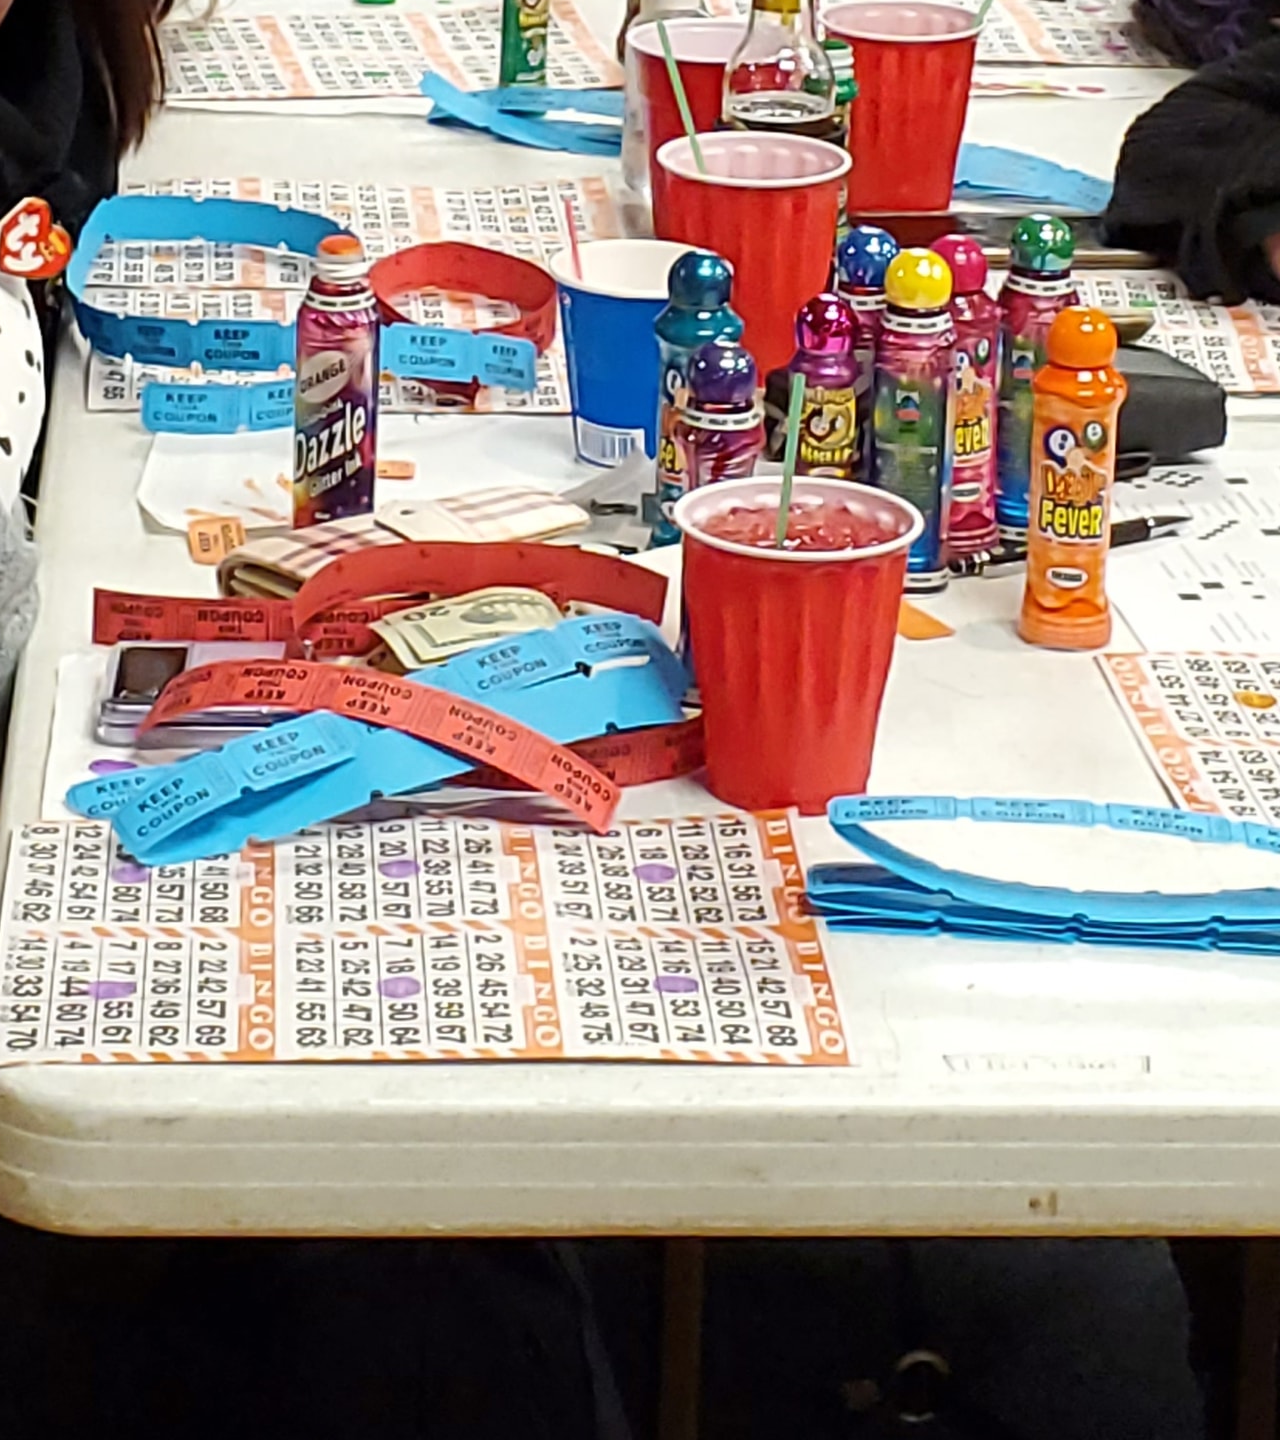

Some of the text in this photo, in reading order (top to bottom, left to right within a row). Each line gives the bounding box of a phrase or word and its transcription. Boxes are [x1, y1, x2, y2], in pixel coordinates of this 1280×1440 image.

[410, 335, 446, 347] KEEP
[299, 358, 346, 394] ORANGE
[153, 410, 217, 422] COUPON
[166, 393, 206, 403] KEEP
[295, 401, 366, 482] Dazzle
[242, 666, 308, 680] COUPON
[477, 645, 521, 668] KEEP
[477, 659, 547, 690] COUPON
[244, 690, 286, 700] KEEP
[343, 674, 412, 699] COUPON
[346, 699, 391, 716] KEEP
[449, 705, 517, 742] COUPON
[252, 731, 299, 754] KEEP
[453, 731, 496, 755] KEEP
[252, 745, 326, 777] COUPON
[551, 754, 610, 801] COUPON
[137, 777, 184, 813] KEEP
[137, 788, 210, 837] COUPON
[554, 782, 593, 812] KEEP
[28, 863, 55, 875] 37
[29, 844, 58, 859] 30
[420, 820, 455, 916] 11 22 39 55 70
[719, 818, 767, 921] 15 16 31 56 73
[25, 879, 53, 897] 46
[678, 824, 723, 923] 11 28 42 52 62
[22, 903, 51, 921] 62
[199, 960, 227, 973] 22
[6, 938, 47, 1050] 14 30 33 54 70
[102, 942, 137, 1043] 7 17 55 61
[149, 942, 182, 1046] 8 27 36 49 62
[198, 977, 227, 993] 42
[249, 944, 274, 1050] BINGO
[296, 940, 326, 1047] 12 23 41 55 63
[340, 942, 373, 1046] 5 25 42 47 62
[386, 939, 420, 1045] 7 18 50 64
[430, 934, 466, 1043] 14 19 39 59 67
[475, 935, 513, 1042] 2 26 45 54 72
[524, 936, 561, 1048] BINGO
[570, 938, 613, 1043] 2 25 32 48 75
[615, 938, 659, 1043] 13 29 31 47 67
[747, 939, 797, 1046] 15 21 42 57 68
[797, 943, 844, 1054] BINGO
[197, 1000, 226, 1018] 57
[196, 1025, 226, 1045] 69
